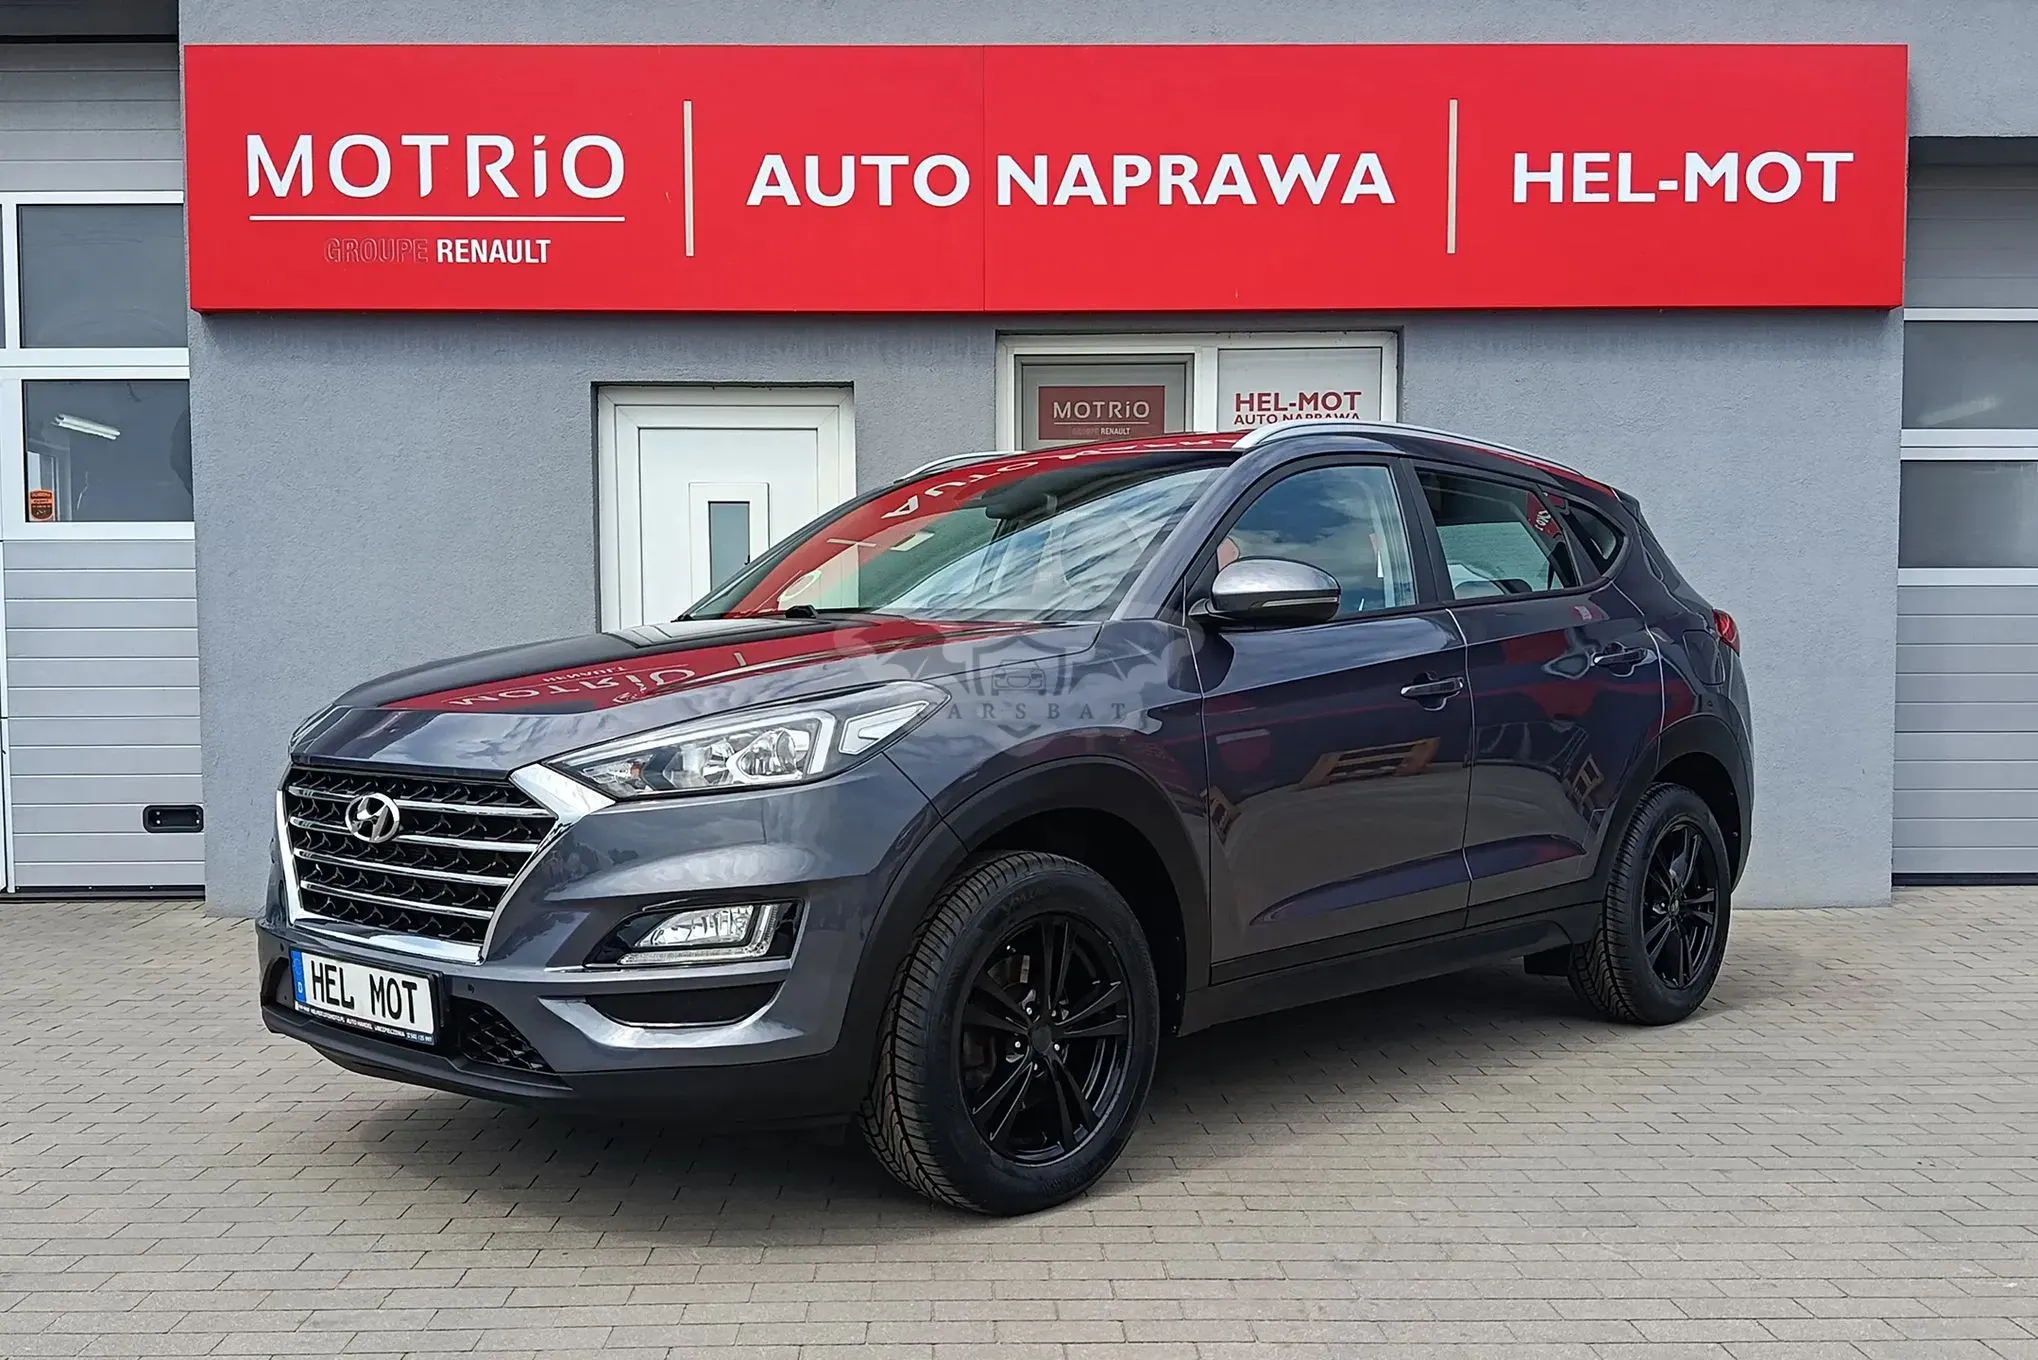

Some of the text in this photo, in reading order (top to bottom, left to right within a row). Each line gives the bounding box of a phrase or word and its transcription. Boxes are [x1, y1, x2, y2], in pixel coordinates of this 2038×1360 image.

[746, 152, 1396, 207] AUTO NAPRAWA
[1513, 151, 1855, 203] HEL-MOT
[325, 238, 552, 264] GROUPE RENAULT
[1235, 391, 1362, 412] HEL-MOT
[1100, 427, 1130, 436] RENAULT
[1233, 413, 1278, 425] AUTO
[311, 960, 355, 1010] HEL
[369, 973, 418, 1024] MOT
